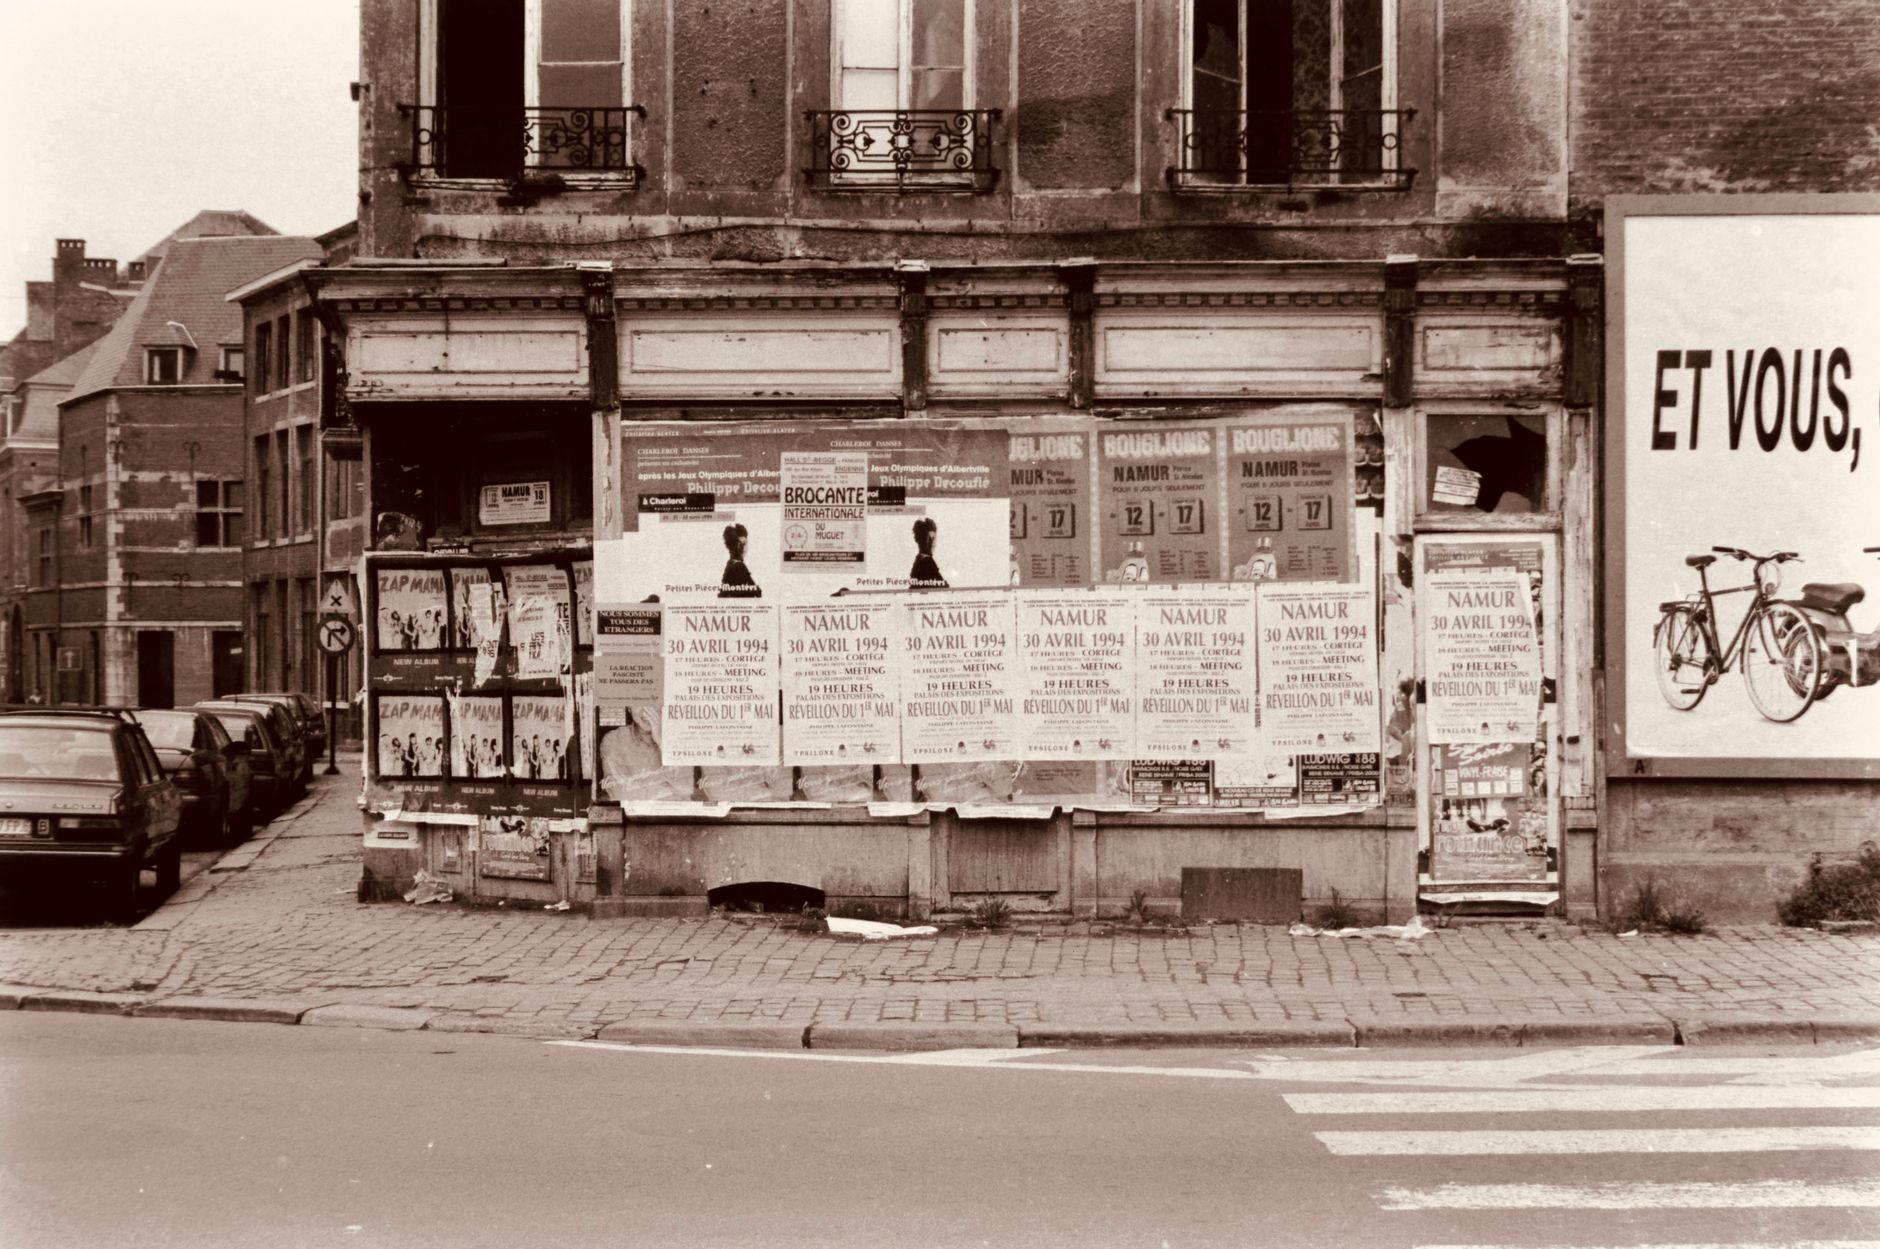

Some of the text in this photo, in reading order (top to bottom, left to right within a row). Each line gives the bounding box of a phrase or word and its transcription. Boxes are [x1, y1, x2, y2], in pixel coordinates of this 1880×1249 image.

[1651, 347, 1861, 472] ET VOUS,
[638, 472, 662, 481] après
[699, 470, 749, 480] Olympiques
[871, 464, 990, 473] Jeux Olympiques d'Albertville
[1114, 465, 1169, 482] NAMUR
[1242, 461, 1298, 477] NAMUR
[687, 482, 740, 495] Philippe
[880, 475, 931, 489] Philippe
[501, 486, 530, 498] NAMUR
[784, 486, 865, 504] BROCANTE
[650, 496, 686, 504] Charleroi
[784, 507, 865, 518] INTERNATIONALE
[1125, 507, 1143, 525] 12
[1176, 505, 1193, 524] 17
[1253, 502, 1271, 521] 12
[1305, 501, 1321, 520] 17
[1049, 509, 1065, 528] 17
[379, 575, 409, 593] ZAP
[665, 584, 692, 592] Petites
[1448, 591, 1515, 608] NAMUR
[1041, 609, 1107, 626] NAMUR
[1161, 608, 1227, 625] NAMUR
[1281, 601, 1348, 620] NAMUR
[686, 615, 751, 632] NAMUR
[804, 614, 870, 631] NAMUR
[922, 610, 988, 629] NAMUR
[1431, 616, 1447, 630] 30
[1452, 615, 1493, 630] AVRIL
[1023, 633, 1125, 648] 30 AVRIL 1994
[1142, 632, 1245, 647] 30 AVRIL 1994
[1264, 625, 1367, 643] 30 AVRIL 1994
[668, 639, 768, 654] 30 AVRIL 1994
[788, 637, 888, 653] 30 AVRIL 1994
[905, 633, 1006, 651] 30 AVRIL 1994
[1488, 645, 1531, 653] MEETING
[1080, 662, 1122, 671] MEETING
[1200, 662, 1242, 670] MEETING
[1323, 655, 1365, 664] MEETING
[1451, 662, 1518, 671] 19 HEURES
[725, 668, 766, 676] MEETING
[845, 666, 886, 675] MEETING
[963, 663, 1005, 672] MEETING
[1044, 679, 1110, 688] 19 HEURES
[1162, 679, 1229, 688] 19 HEURES
[1286, 672, 1353, 683] 19 HEURES
[688, 685, 753, 694] 19 HEURES
[809, 684, 874, 694] 19 HEURES
[927, 680, 993, 691] 19 HEURES
[1486, 681, 1500, 696] DU
[1519, 680, 1537, 695] MAI
[961, 700, 976, 715] DU
[994, 698, 1013, 714] MAI
[1077, 699, 1092, 714] DU
[1110, 698, 1130, 713] MAI
[1196, 698, 1212, 713] DU
[1230, 698, 1249, 713] MAI
[1320, 692, 1335, 707] DU
[1353, 691, 1373, 706] MAI
[380, 702, 409, 719] ZAP
[514, 703, 533, 718] ZAP
[721, 705, 736, 719] DU
[754, 704, 773, 719] MAI
[842, 703, 857, 719] DU
[875, 702, 894, 717] MAI
[1304, 753, 1376, 764] LUDWIG 88
[1634, 759, 1645, 774] A
[414, 785, 439, 793] ALBUM
[475, 787, 495, 795] ALBUM
[40, 821, 48, 832] B
